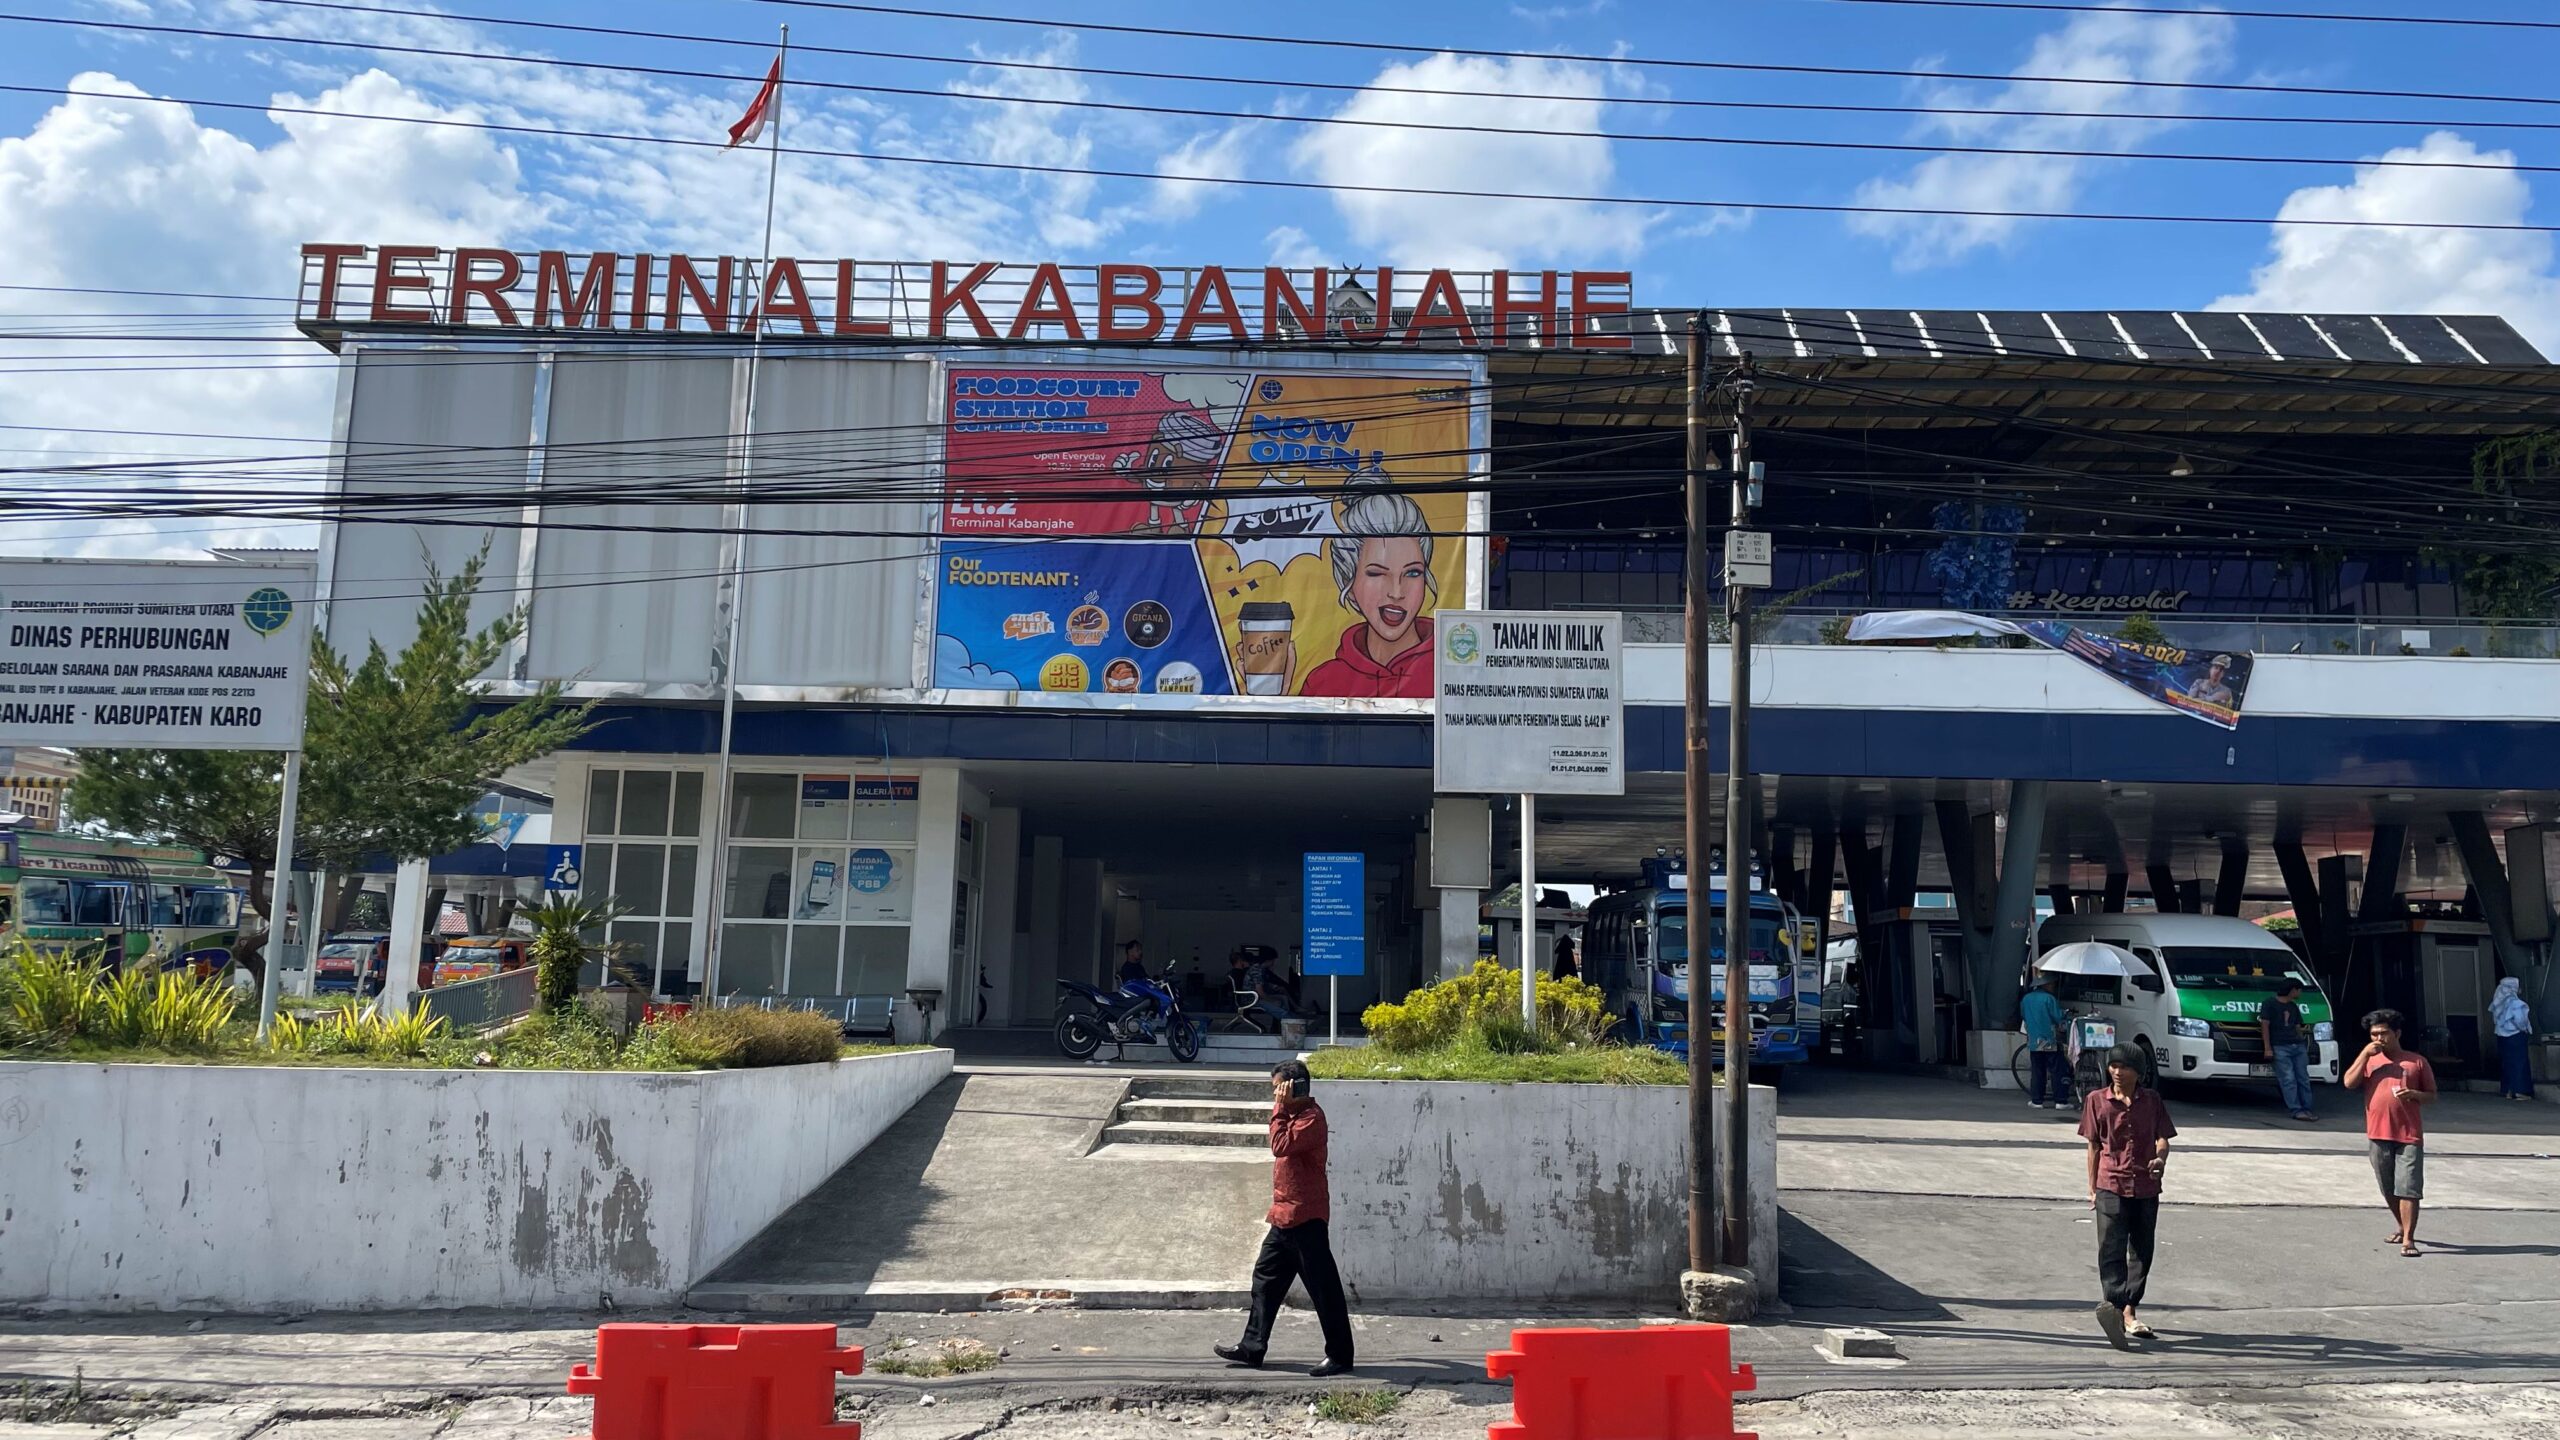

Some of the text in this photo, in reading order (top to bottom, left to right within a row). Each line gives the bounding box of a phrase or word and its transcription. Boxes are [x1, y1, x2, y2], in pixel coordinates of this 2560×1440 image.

[302, 244, 1633, 349] TERMINAL KABANJAHE
[955, 377, 1141, 397] FOODCOURT
[954, 400, 1088, 418] STATION
[1252, 414, 1355, 444] NOW
[1062, 452, 1106, 462] Everyday
[1249, 440, 1383, 474] OPEN !
[950, 517, 1074, 530] Terminal Kabanjahe
[949, 556, 982, 571] Our
[11, 601, 234, 616] PEMERINTAH PROVINSI SUMATERA UTARA
[10, 625, 230, 650] DINAS PERHUBUNGAN
[1493, 623, 1604, 651] TANAH INI MILIK
[1486, 655, 1609, 670] PEMERINTAH PROVINSI SUMATERA UTARA
[2144, 645, 2187, 666] 2024
[62, 663, 109, 676] SARANA
[114, 664, 138, 677] DAN
[143, 665, 213, 678] PRASARANA
[217, 666, 288, 679] KABANJAHE
[19, 685, 36, 694] BUS
[39, 685, 56, 694] TIPE
[121, 686, 146, 695] JALAN
[150, 687, 185, 696] VETERAN
[188, 688, 209, 696] KODE
[212, 688, 228, 697] POS
[1444, 684, 1609, 700] DINAS PERHUBUNGAN PROVINSI SUMATERA UTARA
[0, 703, 75, 724] ANJAHE
[94, 704, 202, 726] KABUPATEN
[210, 706, 262, 727] KARO
[1445, 713, 1464, 726] TANAH
[1466, 714, 1497, 726] BANGUNAN
[1499, 714, 1522, 727] KANTOR
[1523, 714, 1559, 727] PEMERINTAH
[1561, 715, 1582, 727] SELUAS
[856, 787, 913, 796] GALERI ATM
